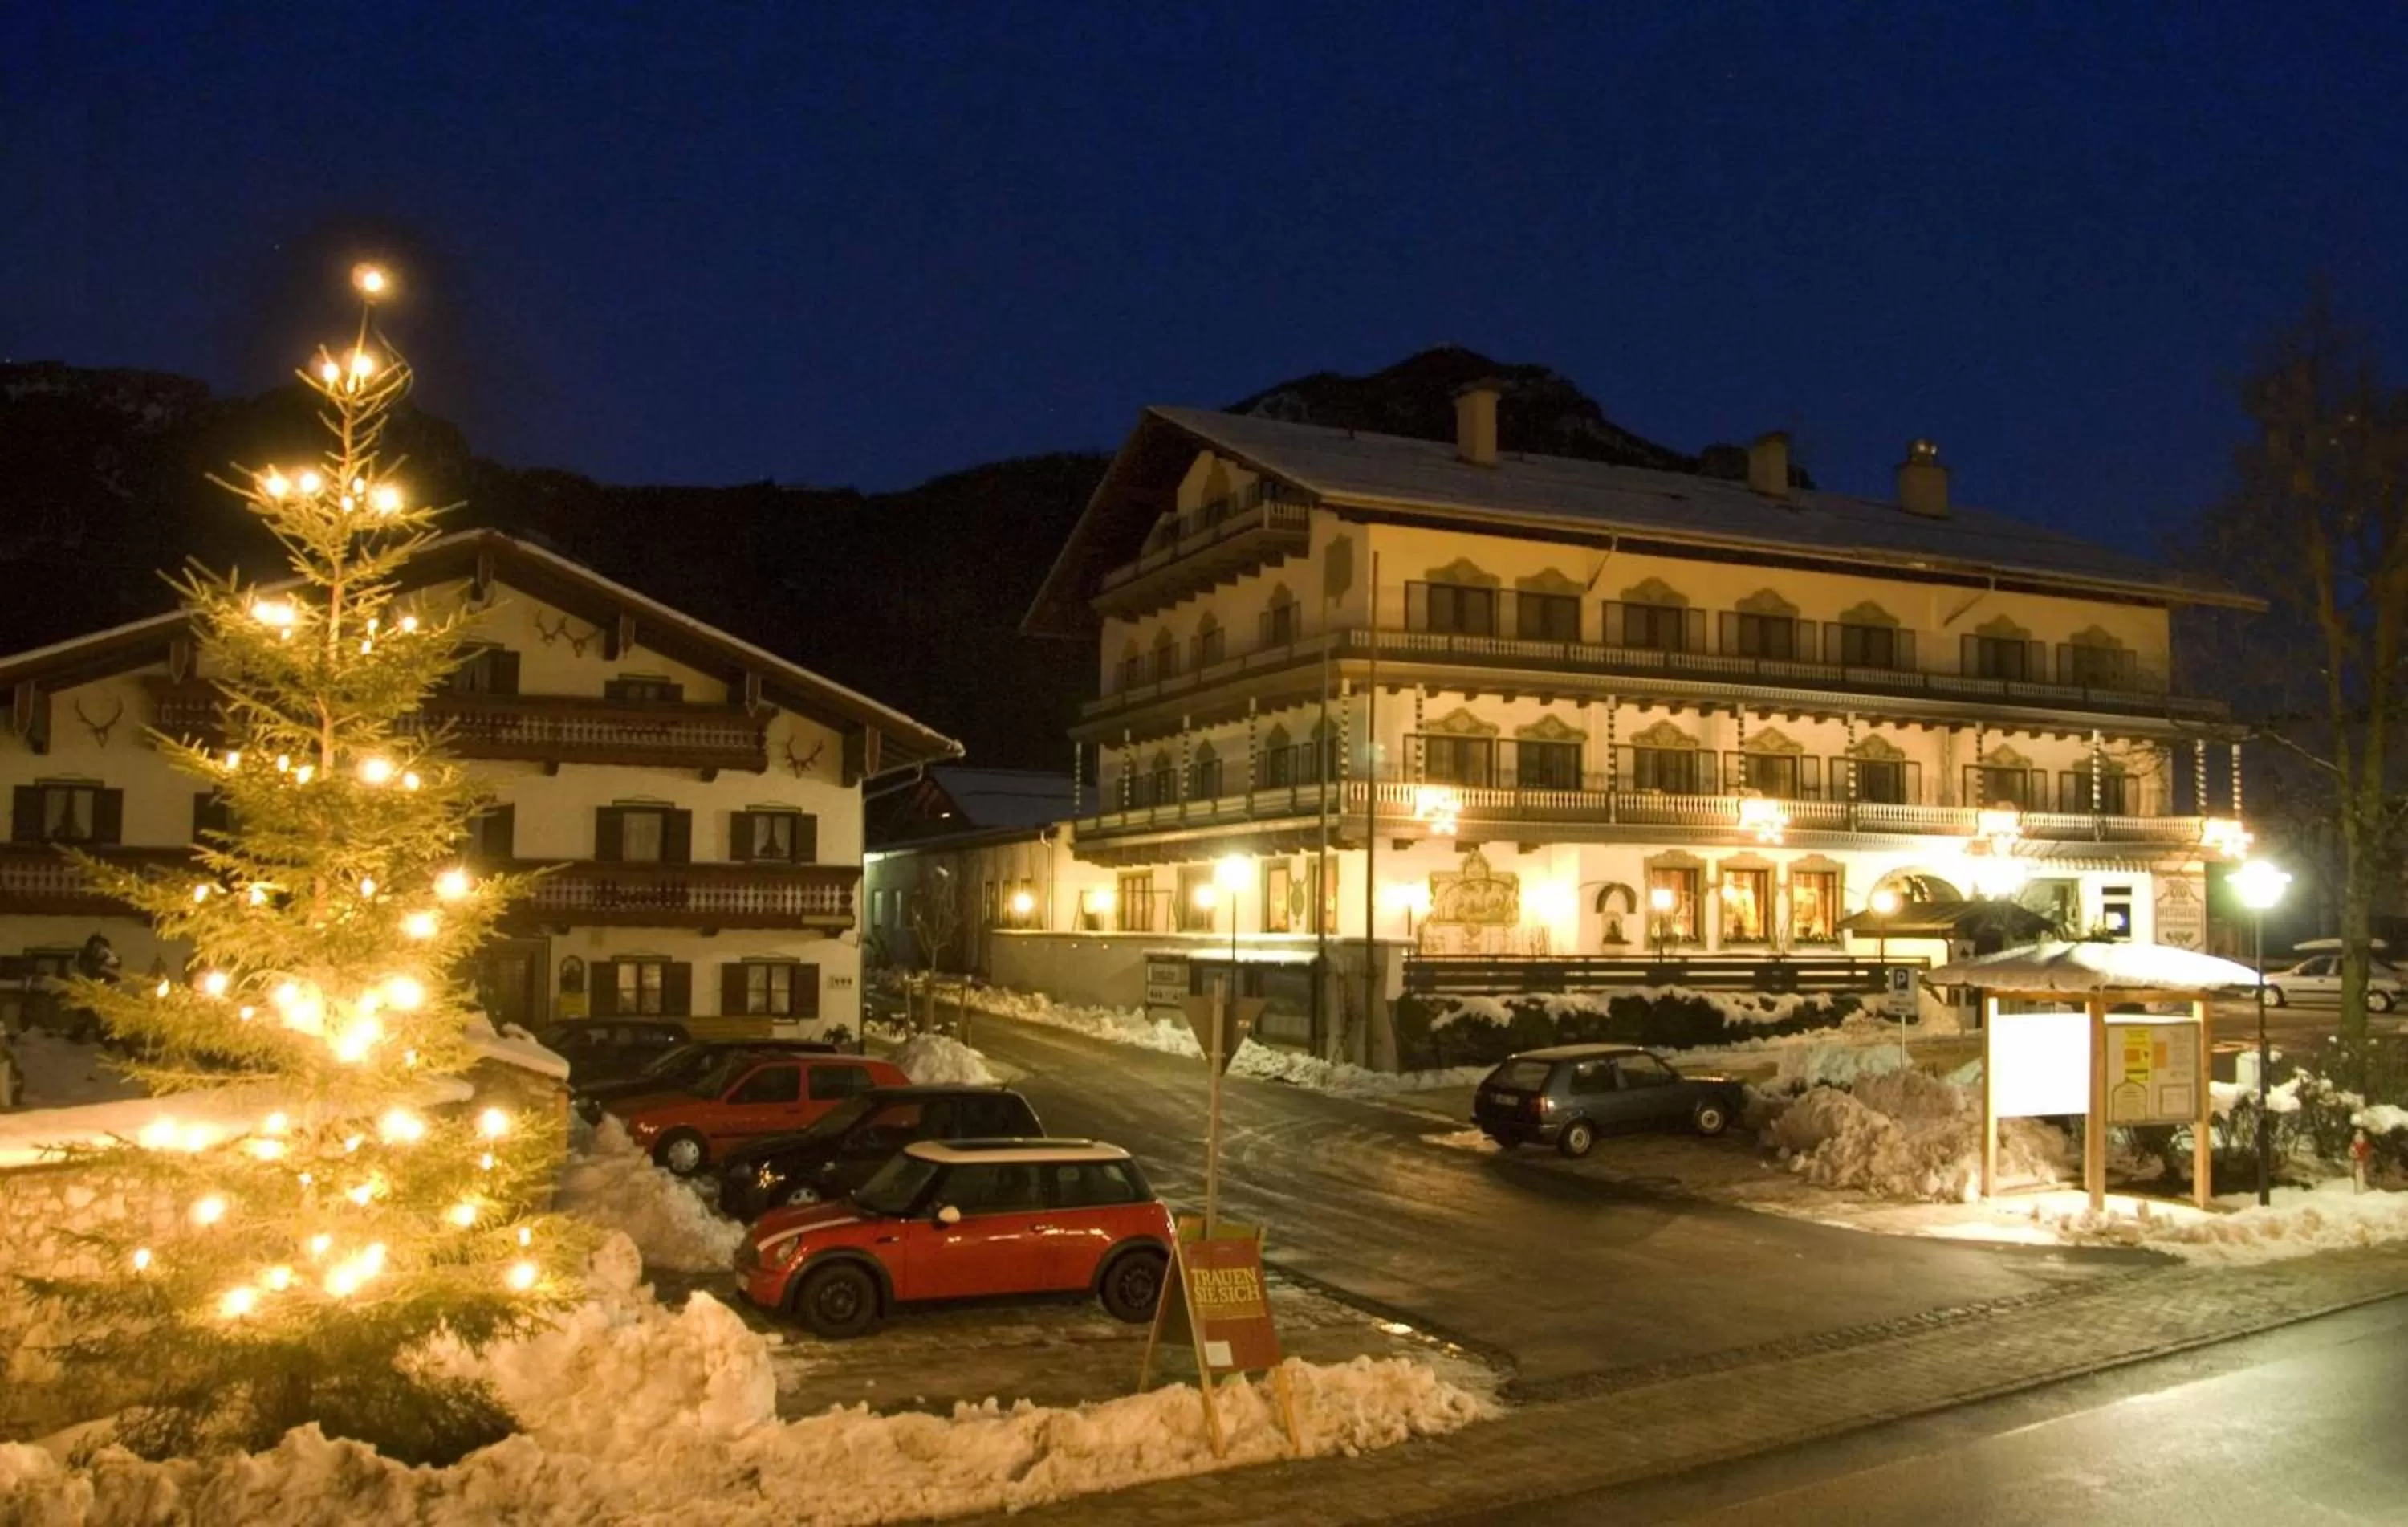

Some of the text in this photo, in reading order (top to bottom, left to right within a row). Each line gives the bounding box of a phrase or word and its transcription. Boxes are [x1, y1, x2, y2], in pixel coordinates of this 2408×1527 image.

[1897, 971, 1907, 987] P
[1190, 1267, 1258, 1286] TRAUEN
[1194, 1284, 1262, 1303] SIE SICH
